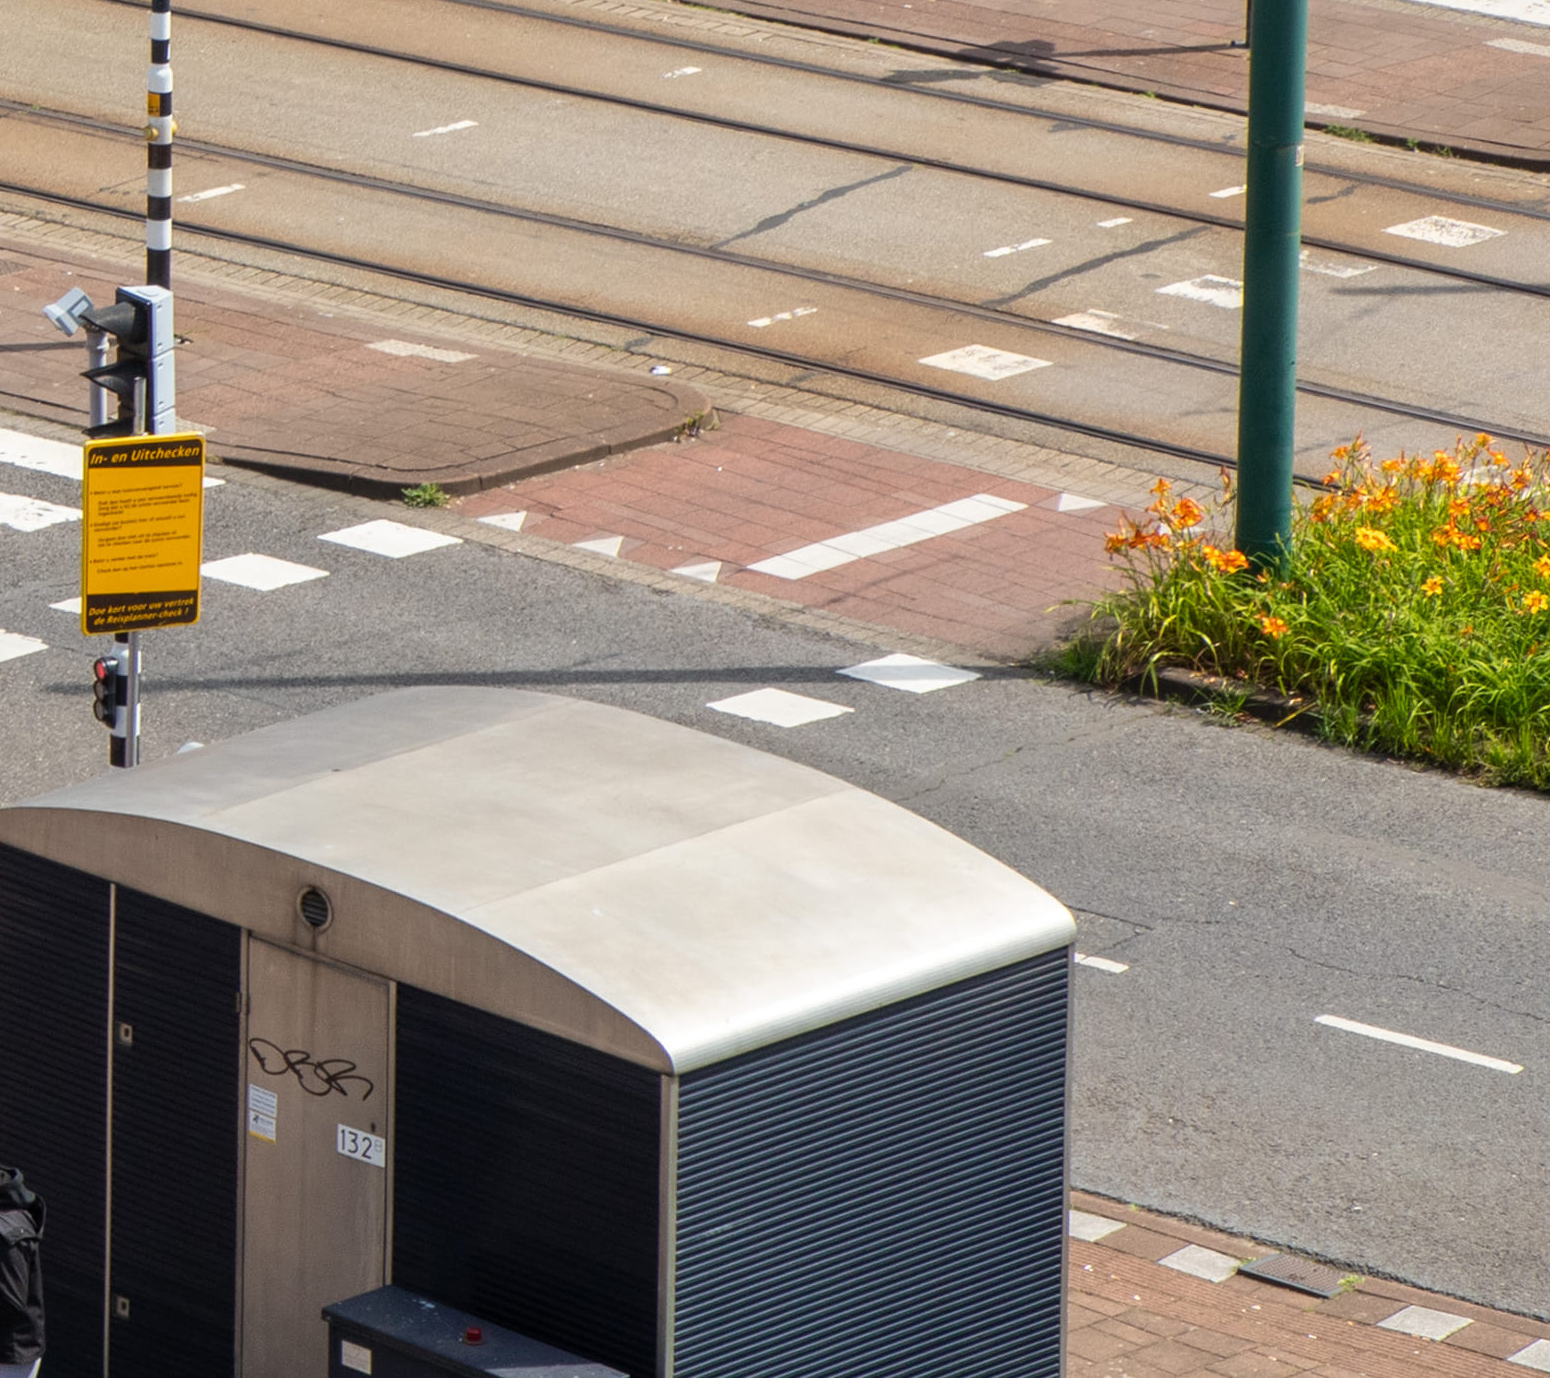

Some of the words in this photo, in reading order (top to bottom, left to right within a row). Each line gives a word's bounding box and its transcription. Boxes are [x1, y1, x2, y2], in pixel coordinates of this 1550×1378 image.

[90, 451, 108, 465] In-
[111, 453, 126, 463] en
[131, 445, 200, 462] Uitchecken
[89, 606, 106, 617] Doe
[108, 604, 126, 615] kort
[127, 602, 147, 612] voor
[148, 600, 163, 610] uw
[164, 597, 194, 608] vertrek
[94, 615, 105, 626] de
[340, 1129, 372, 1160] 132
